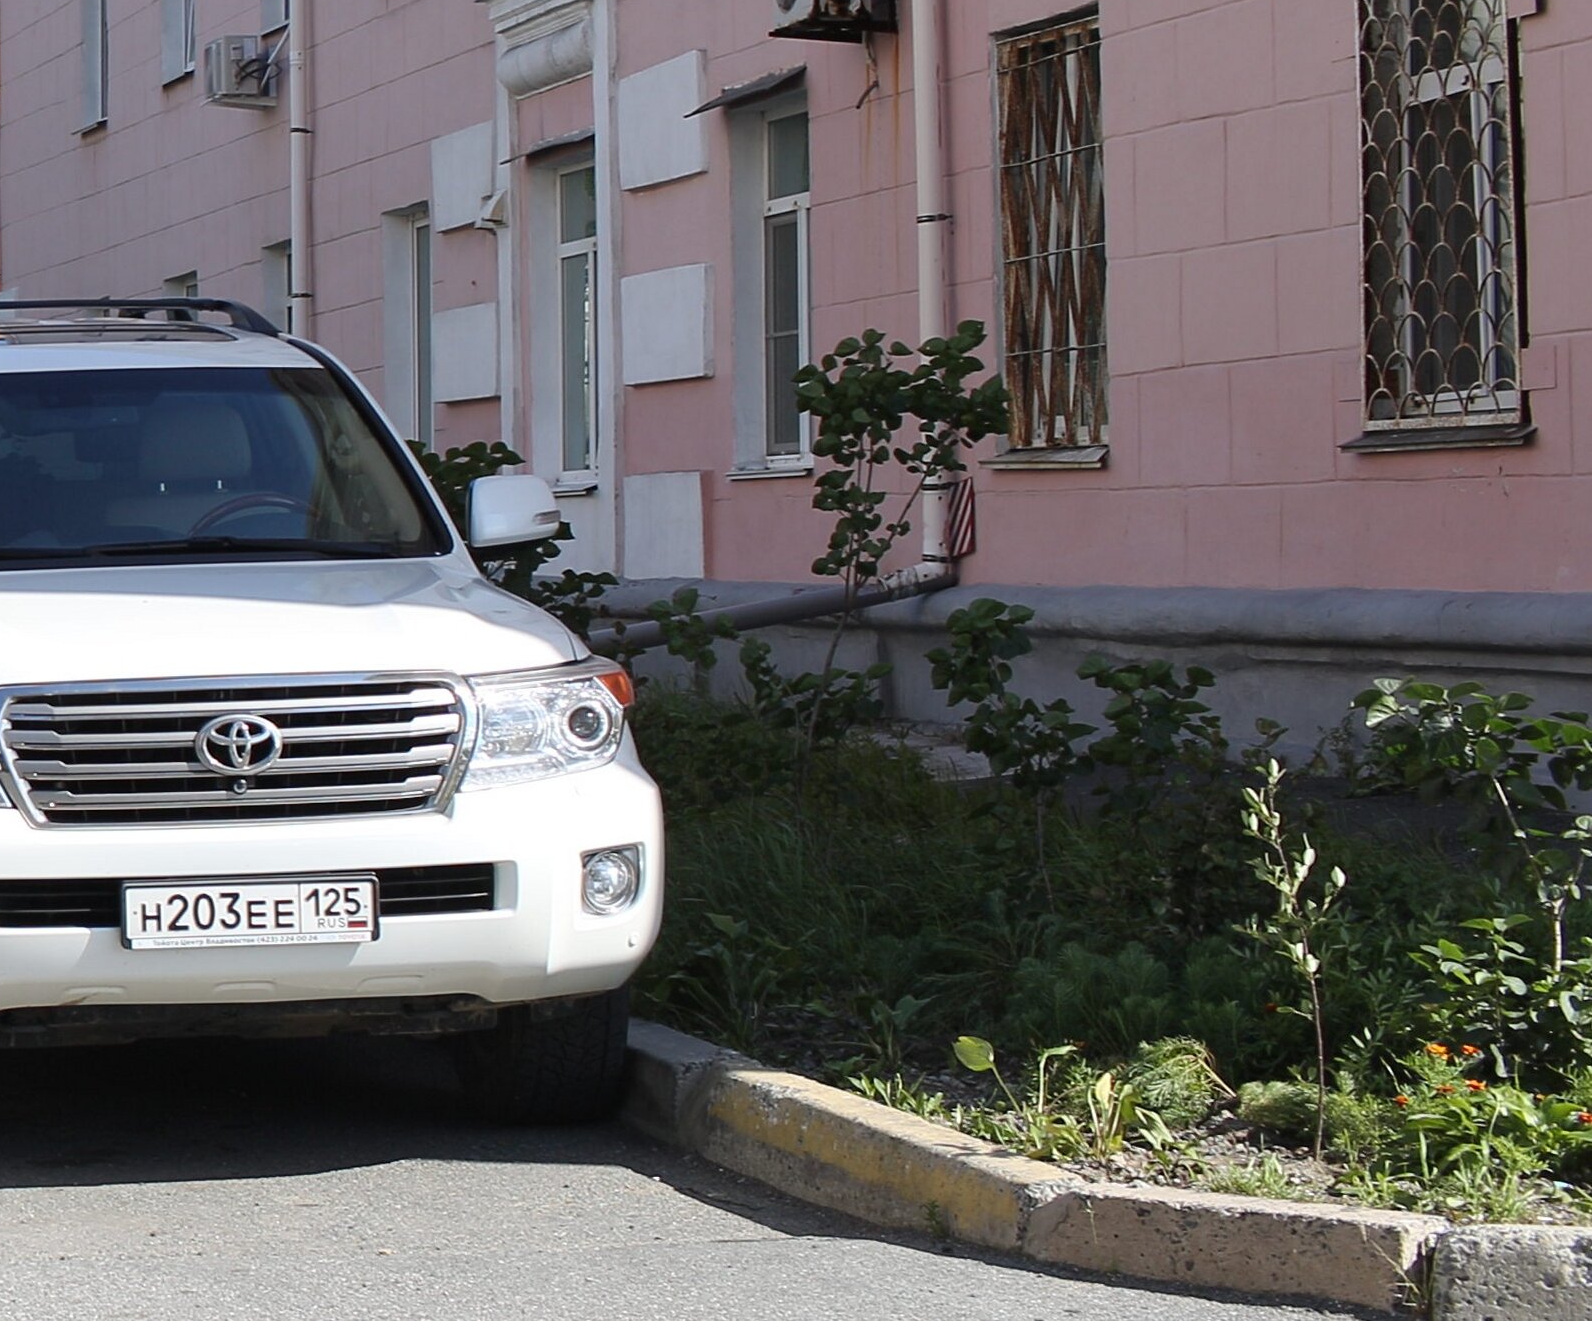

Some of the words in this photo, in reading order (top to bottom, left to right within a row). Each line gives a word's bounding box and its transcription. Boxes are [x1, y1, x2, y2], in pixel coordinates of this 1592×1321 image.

[141, 892, 294, 931] Н203ЕЕ
[305, 887, 361, 917] 125
[317, 917, 345, 928] RUS
